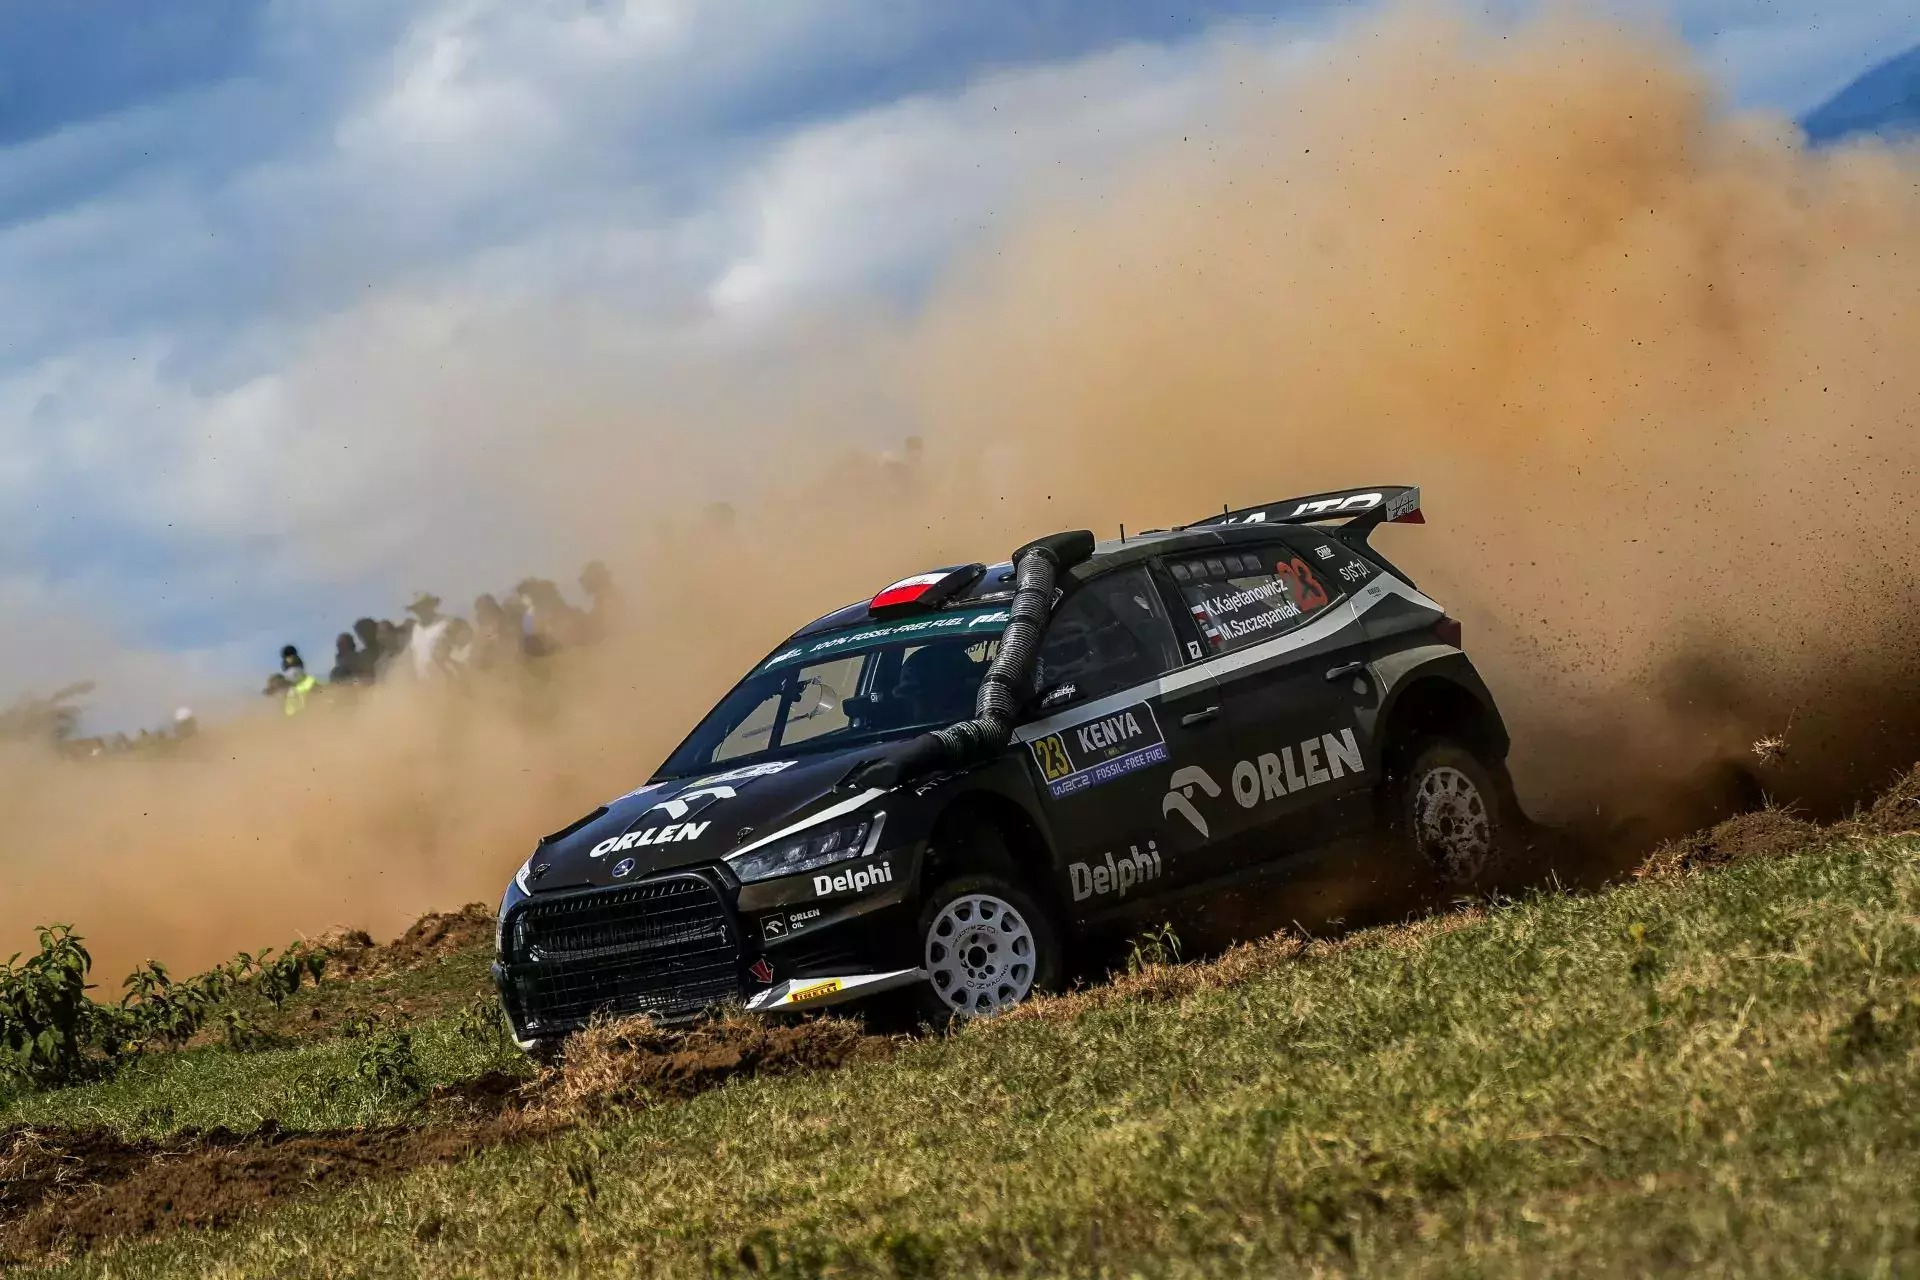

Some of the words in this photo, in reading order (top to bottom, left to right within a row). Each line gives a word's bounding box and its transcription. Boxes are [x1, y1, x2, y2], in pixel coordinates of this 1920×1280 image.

[1202, 578, 1288, 616] K.Kajetanowicz
[929, 617, 963, 628] FUEL
[1219, 600, 1301, 641] M.Szczepaniak
[1077, 712, 1142, 753] KENYA
[1036, 737, 1068, 779] 23
[1096, 755, 1145, 781] FOSSIL-FREE
[1147, 748, 1167, 764] FUEL
[1232, 728, 1365, 809] ORLEN
[589, 821, 712, 858] ORLEN
[813, 862, 893, 897] Delphi
[1069, 841, 1161, 901] Delphi
[789, 908, 821, 922] ORLEN
[791, 922, 804, 930] OIL
